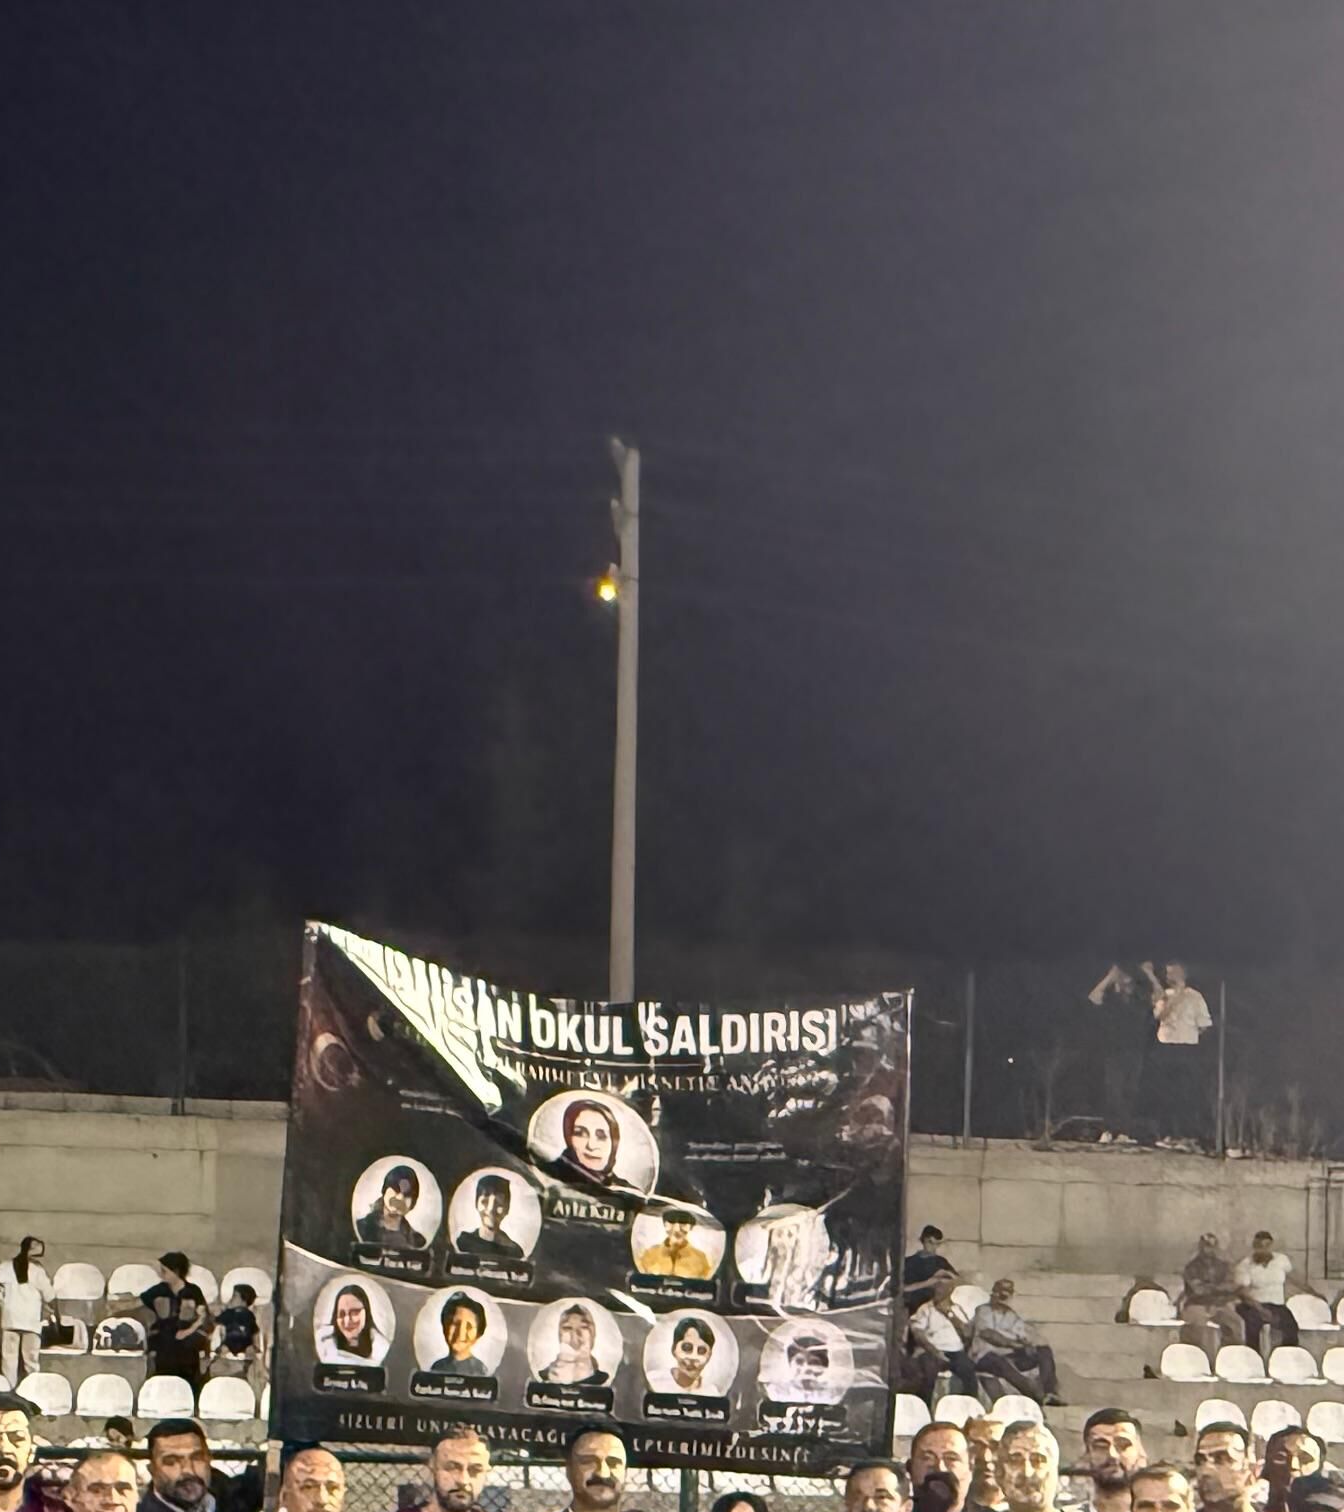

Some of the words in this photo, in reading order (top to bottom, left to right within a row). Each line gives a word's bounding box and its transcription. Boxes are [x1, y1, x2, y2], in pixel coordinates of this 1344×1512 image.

[529, 993, 635, 1056] OKUL
[642, 1002, 837, 1057] SALDIRISI
[416, 1417, 566, 1446] UNAYACAĞI
